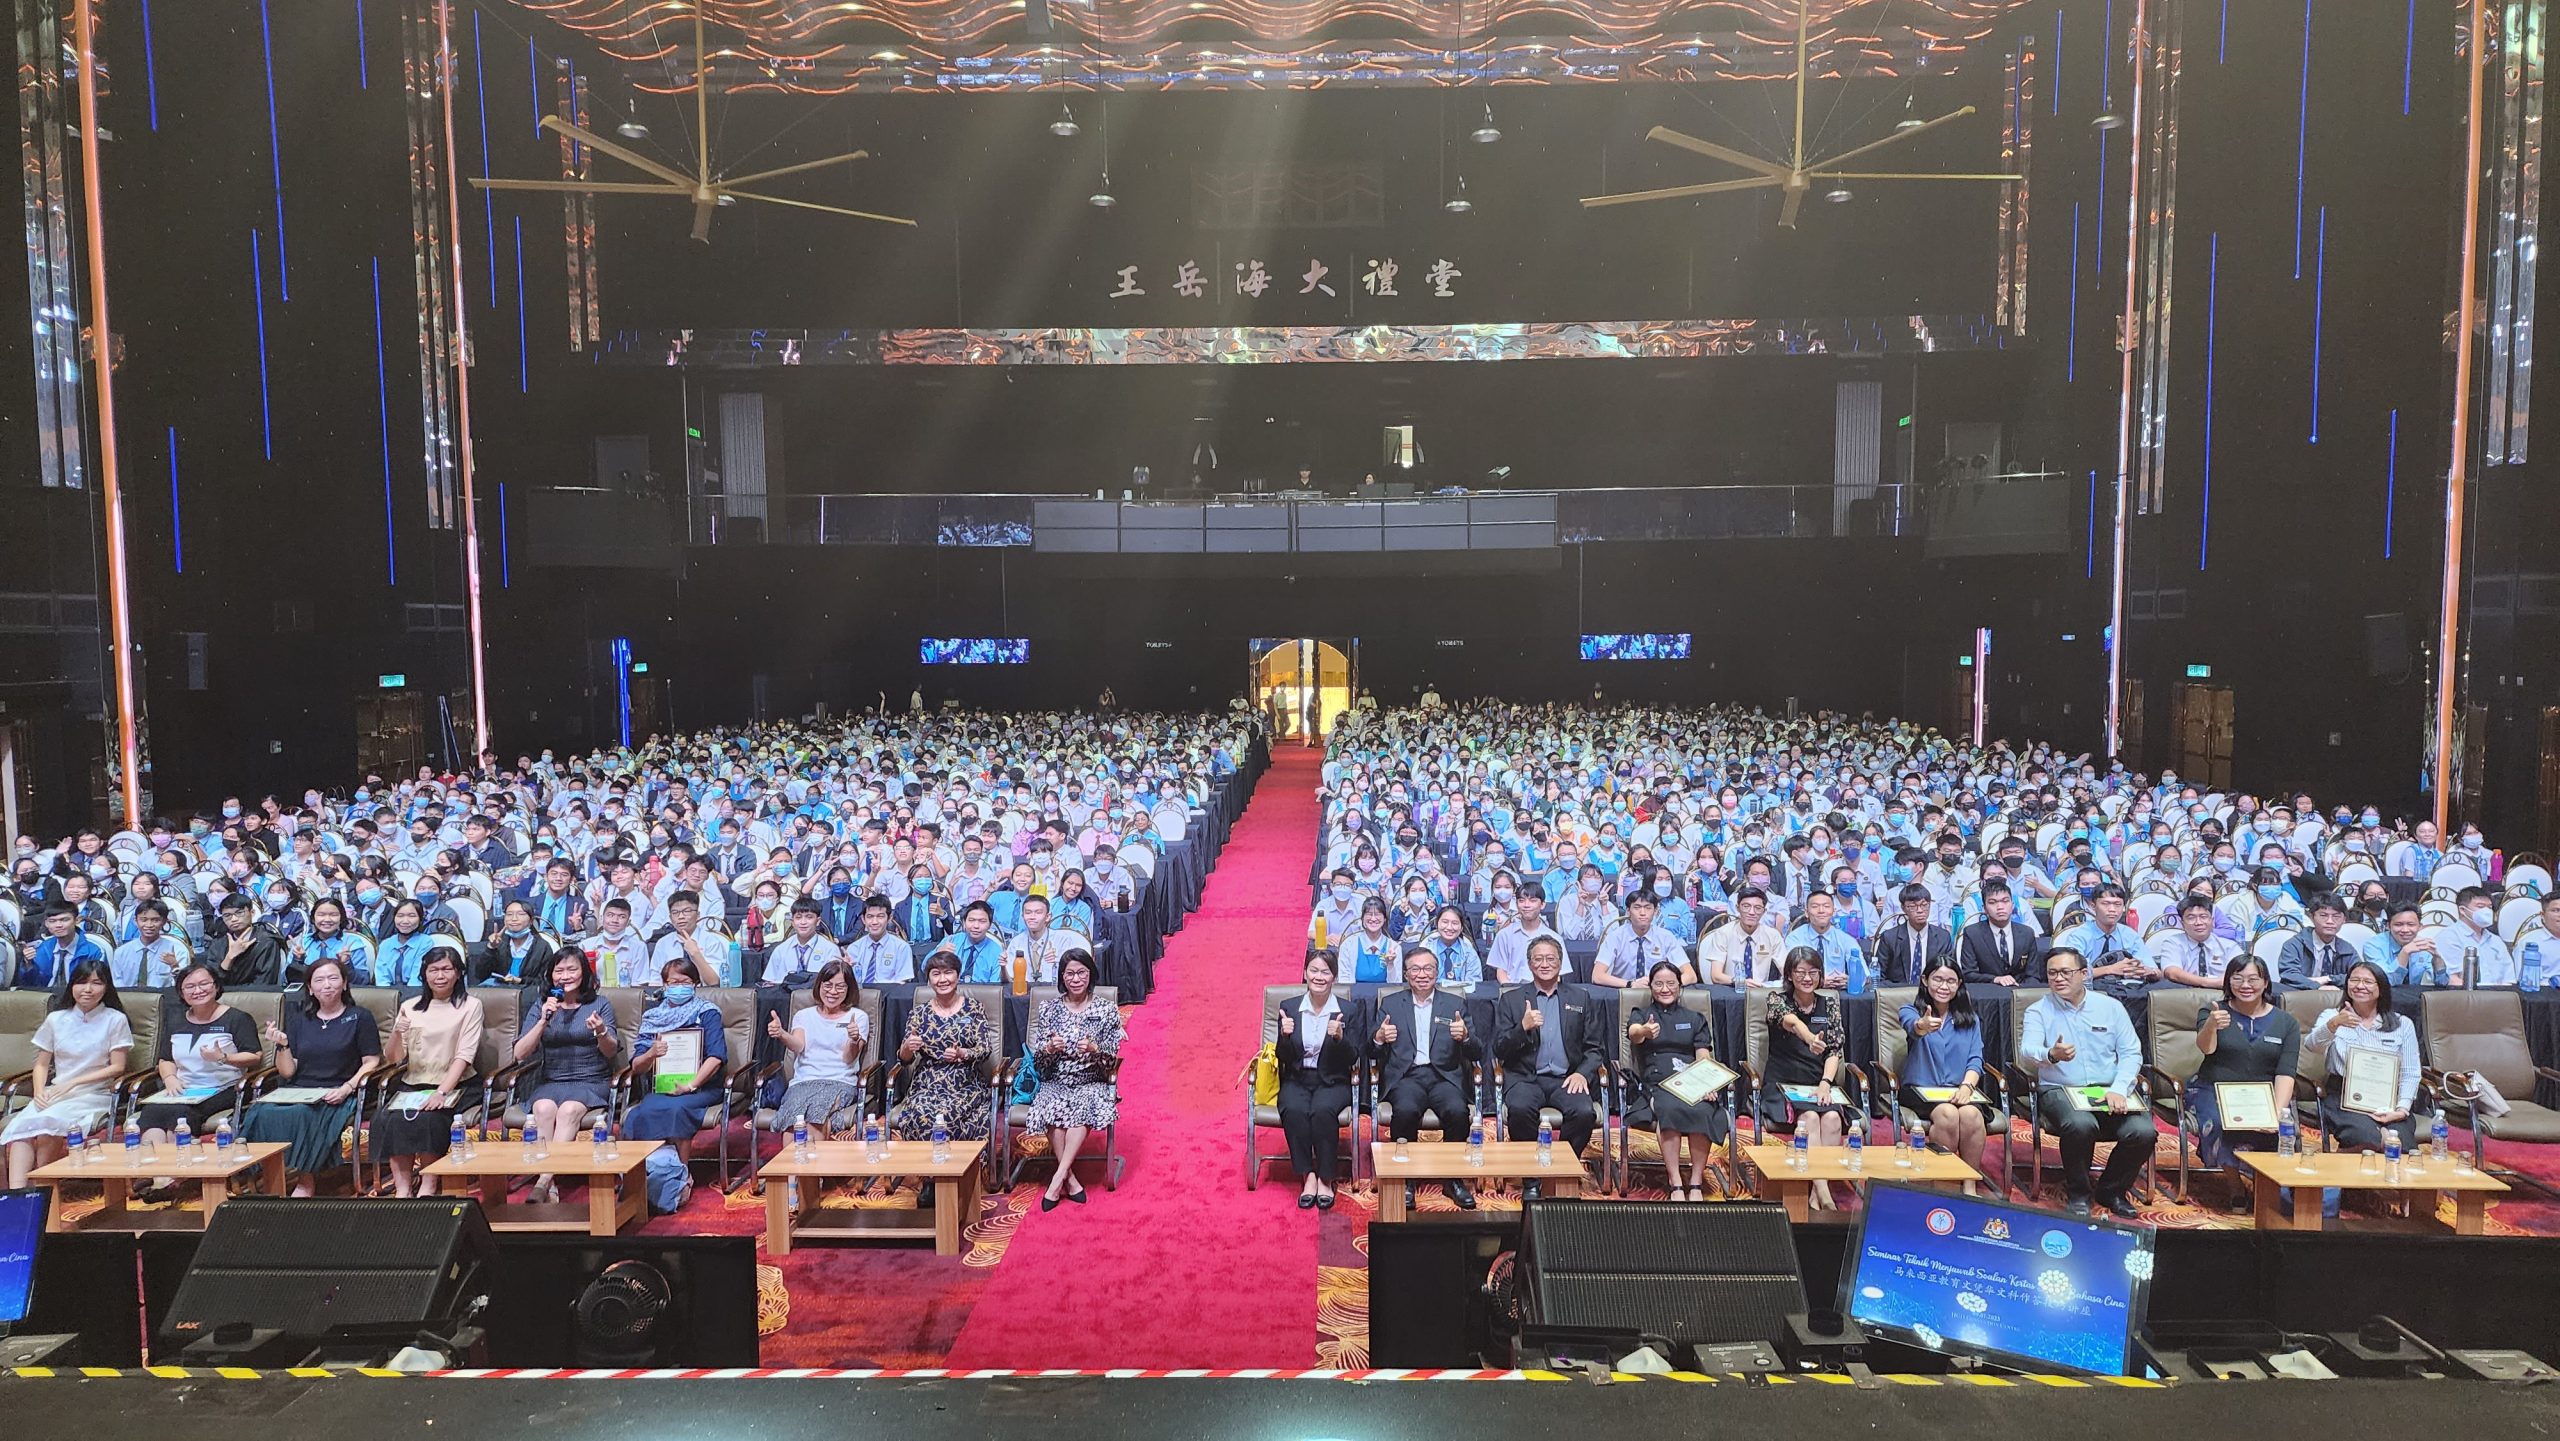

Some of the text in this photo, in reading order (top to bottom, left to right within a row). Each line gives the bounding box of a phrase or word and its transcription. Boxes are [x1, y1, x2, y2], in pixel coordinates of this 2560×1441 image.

[1109, 258, 1463, 299] 王岳海大禮堂
[9, 1252, 30, 1262] Cina
[1867, 1246, 1902, 1262] Seminar
[1903, 1253, 1930, 1268] Teknik
[1930, 1260, 1975, 1276] Menjawab
[1976, 1268, 2008, 1284] Soalan
[2009, 1274, 2036, 1290] Kertas
[2103, 1295, 2127, 1309] Cina
